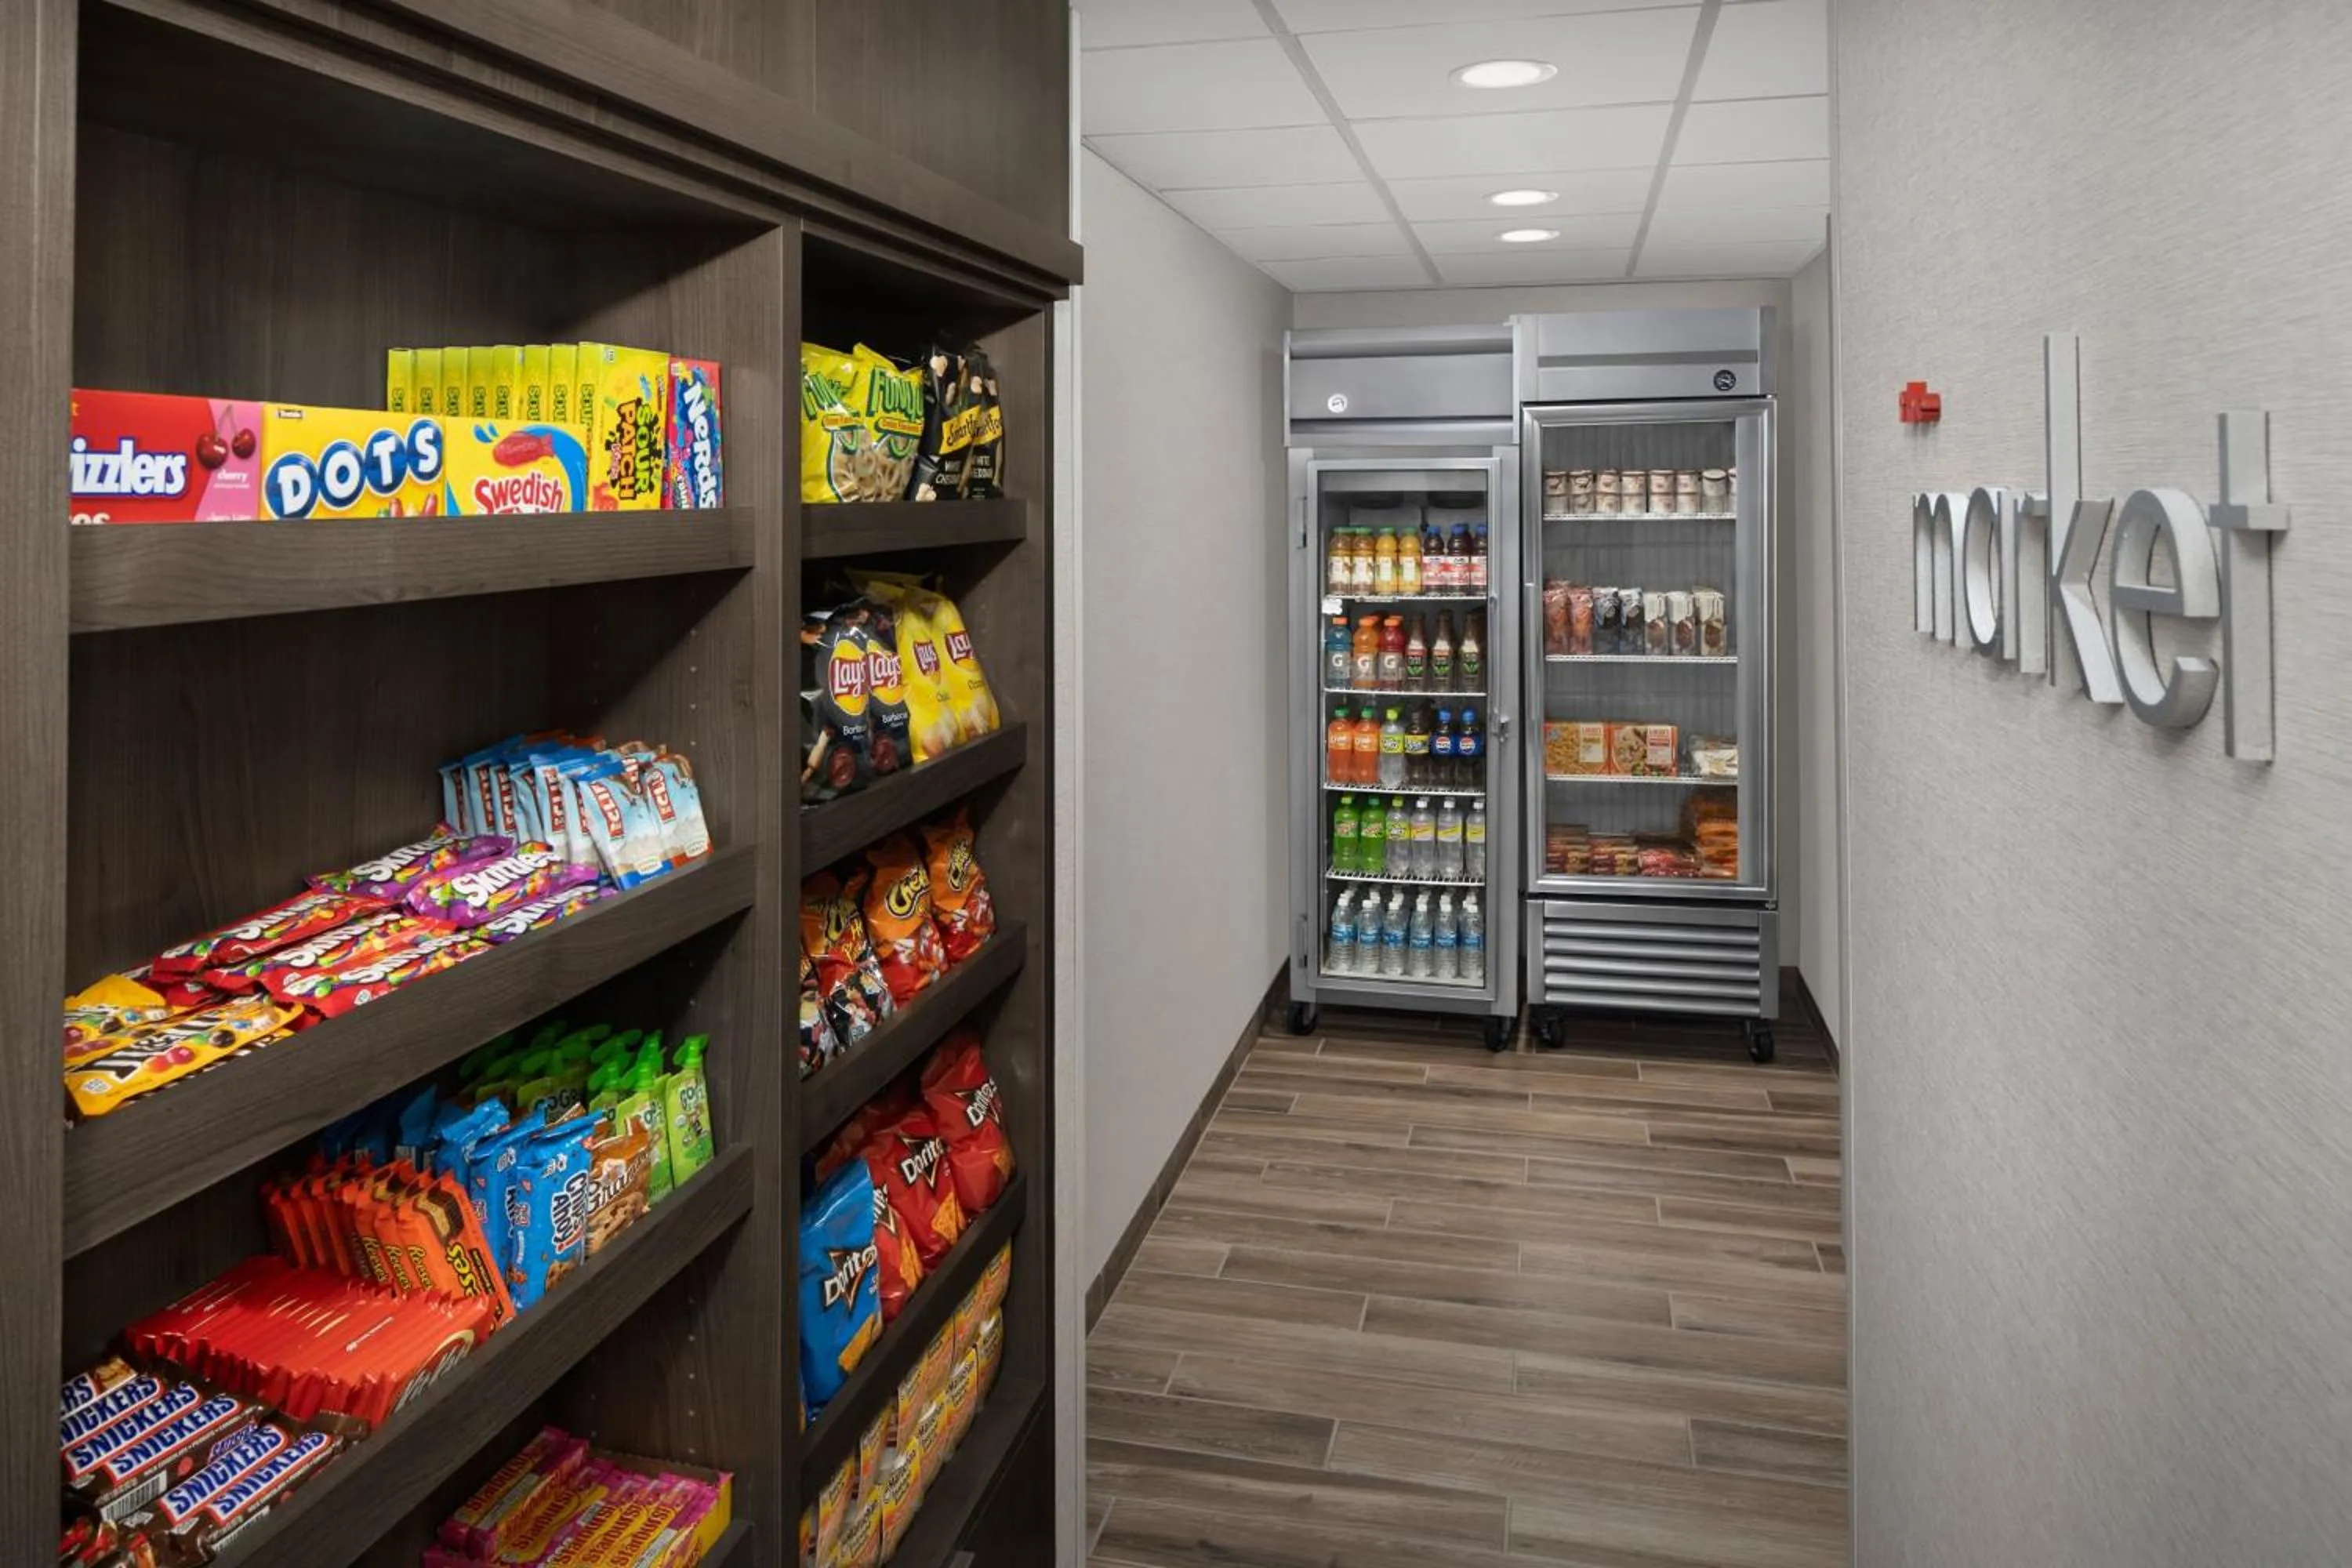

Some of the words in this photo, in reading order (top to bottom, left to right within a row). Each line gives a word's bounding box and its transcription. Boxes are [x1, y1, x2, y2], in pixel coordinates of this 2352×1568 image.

[70, 437, 187, 495] izzlers
[278, 427, 438, 515] DOTS
[619, 401, 637, 499] PATCH
[636, 403, 652, 492] SOUR
[474, 472, 565, 515] Swedish
[1913, 332, 2290, 762] market
[60, 1375, 158, 1446] NICKERS
[72, 1383, 198, 1471] SNICKERS
[111, 1396, 237, 1475] SNICKERS
[167, 1426, 285, 1516] SNICKERS
[212, 1431, 327, 1516] SNICKERS
